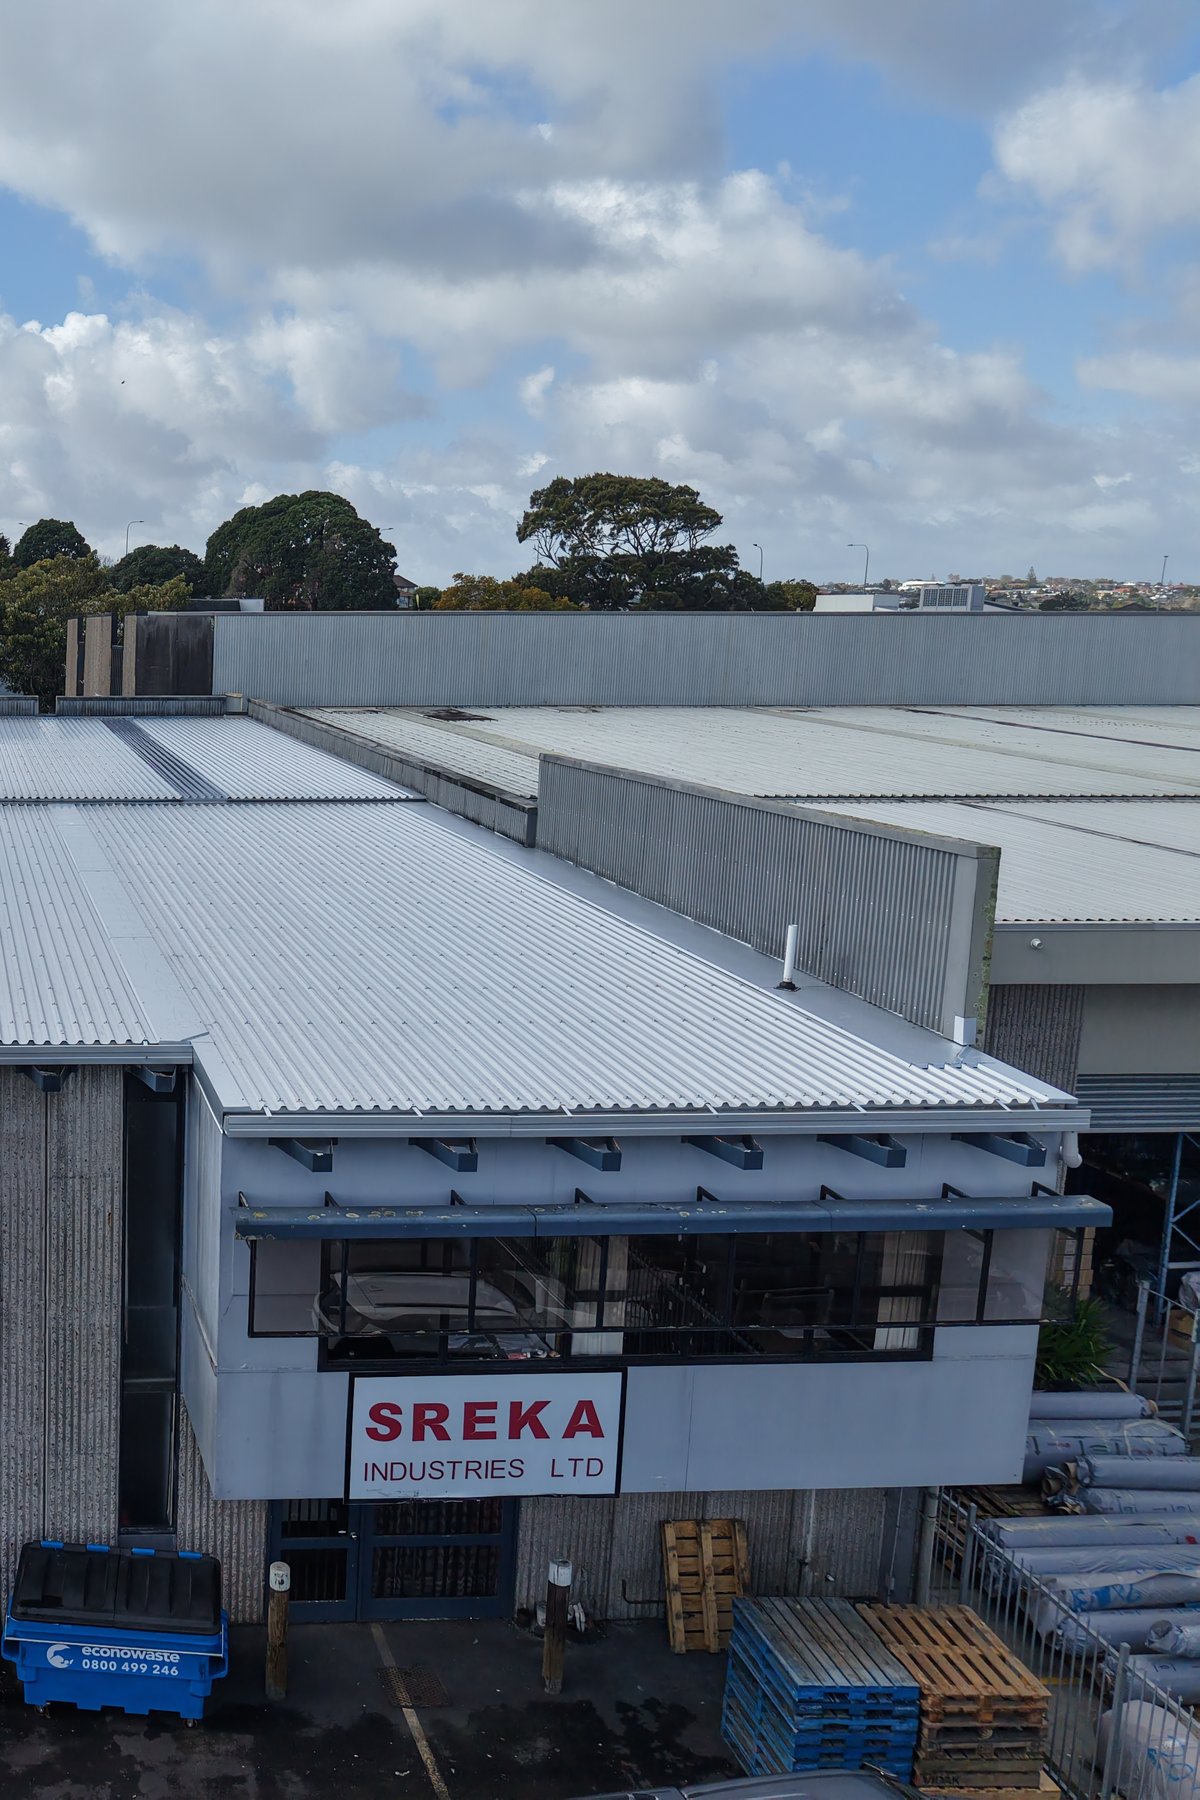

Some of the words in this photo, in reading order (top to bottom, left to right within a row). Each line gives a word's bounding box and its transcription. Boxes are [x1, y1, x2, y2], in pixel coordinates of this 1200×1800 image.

[365, 1399, 605, 1442] SREKA
[364, 1458, 525, 1482] INDUSTRIES
[550, 1457, 604, 1478] LTD
[81, 1645, 181, 1663] econowaste
[82, 1658, 117, 1671] 0800
[121, 1662, 148, 1673] 499
[152, 1665, 179, 1676] 246
